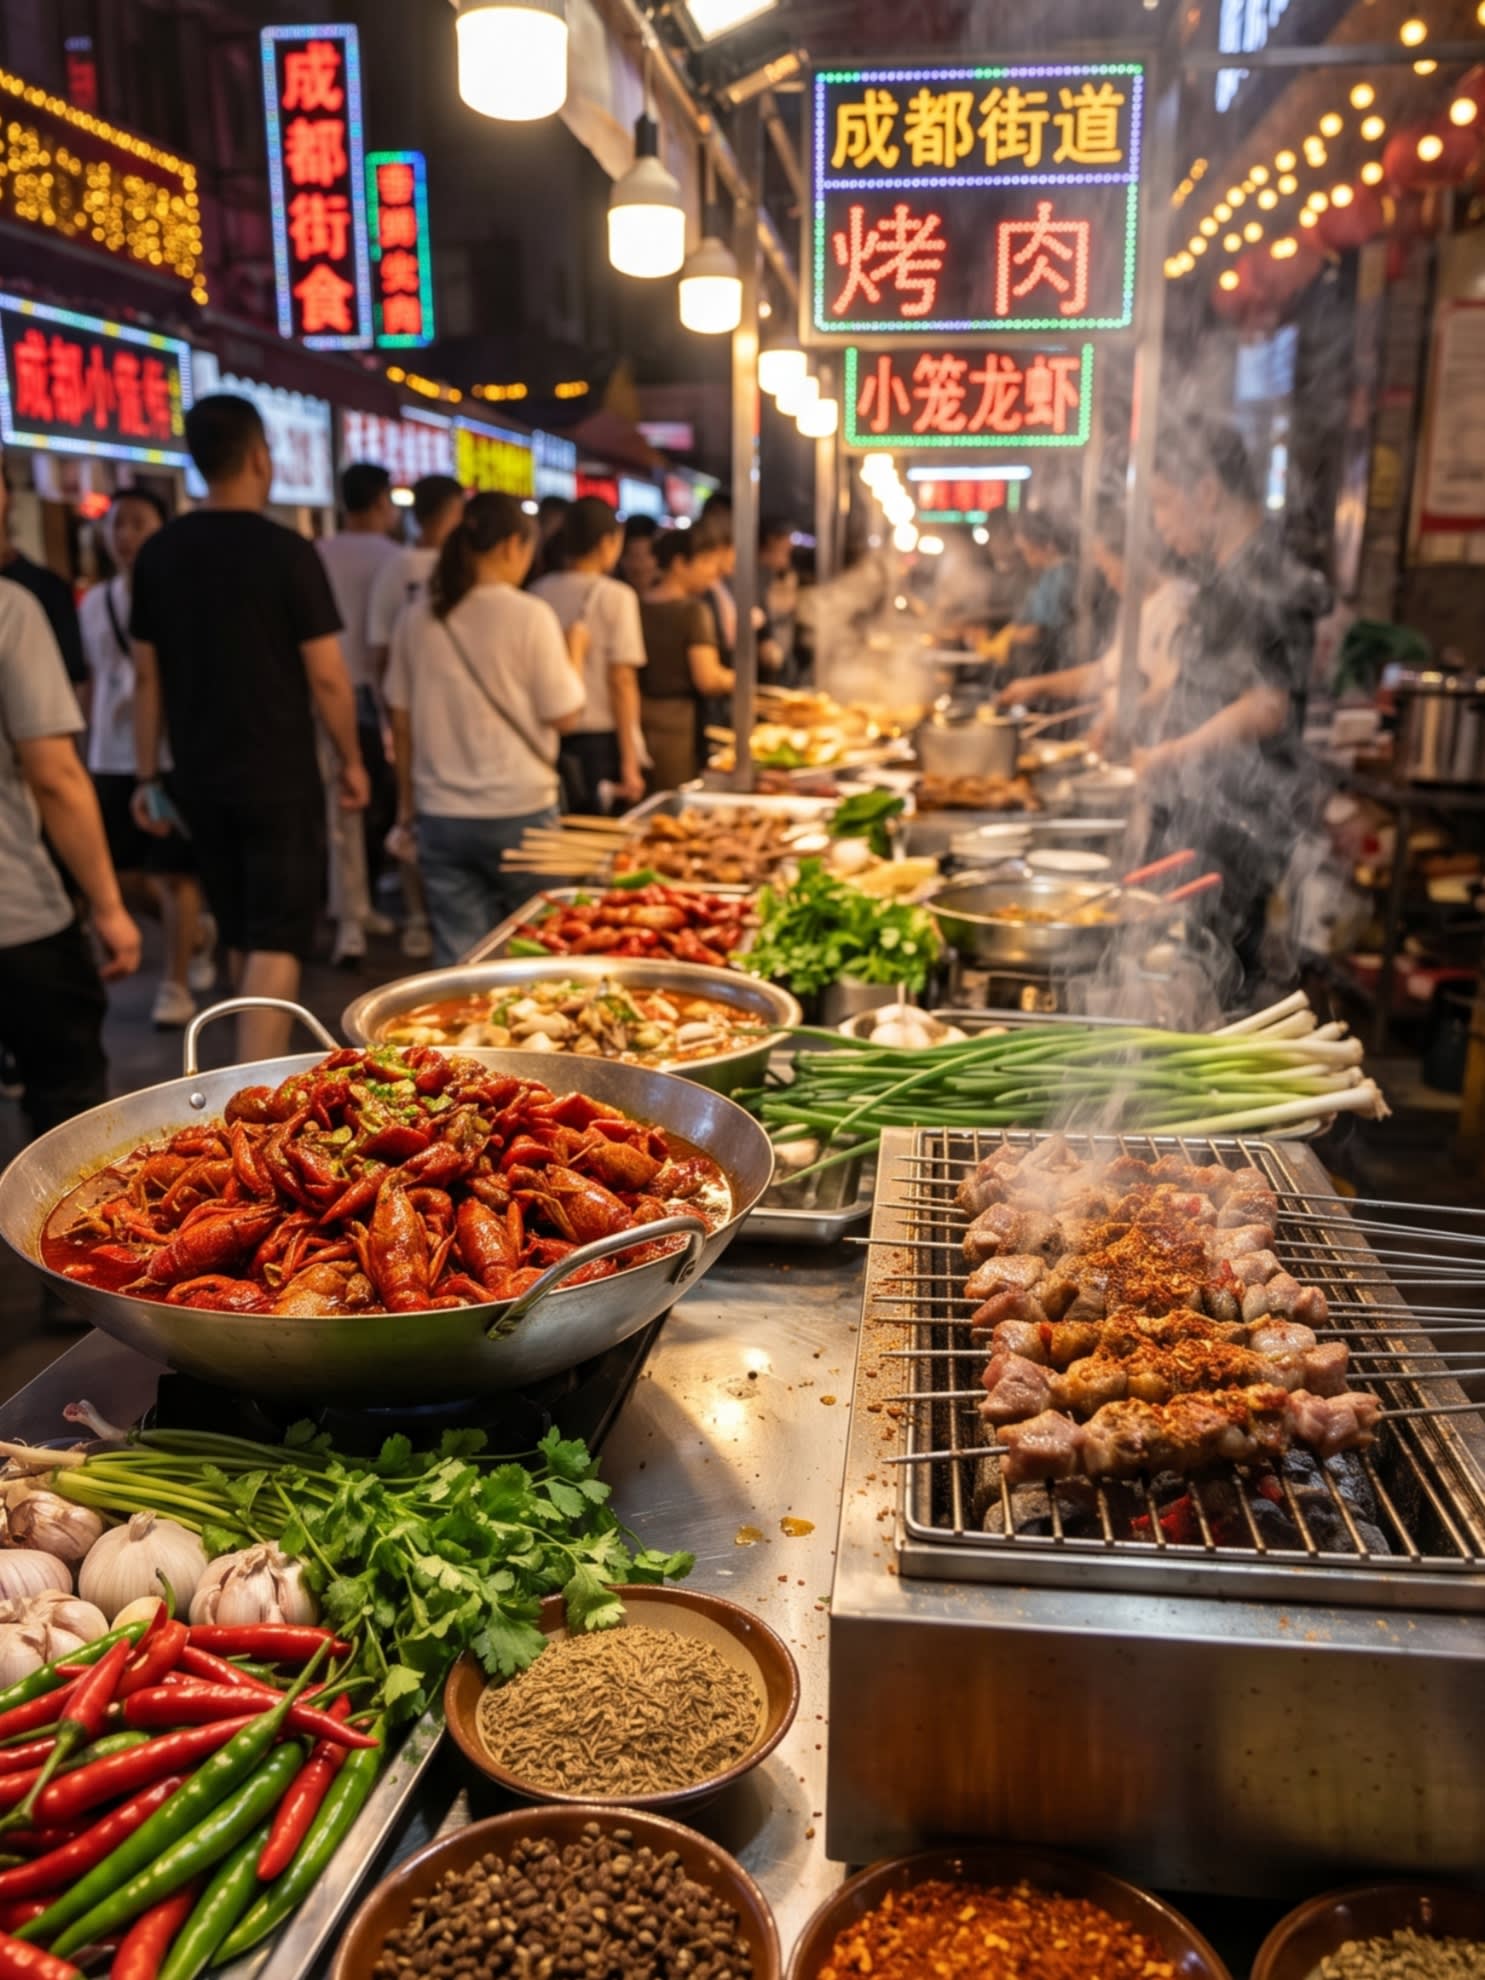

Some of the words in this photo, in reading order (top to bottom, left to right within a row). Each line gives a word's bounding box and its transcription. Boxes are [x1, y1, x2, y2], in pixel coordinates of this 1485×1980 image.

[831, 82, 1125, 169] 成都街道
[282, 40, 354, 334] 成都街食
[857, 352, 1081, 433] 小笼龙虾
